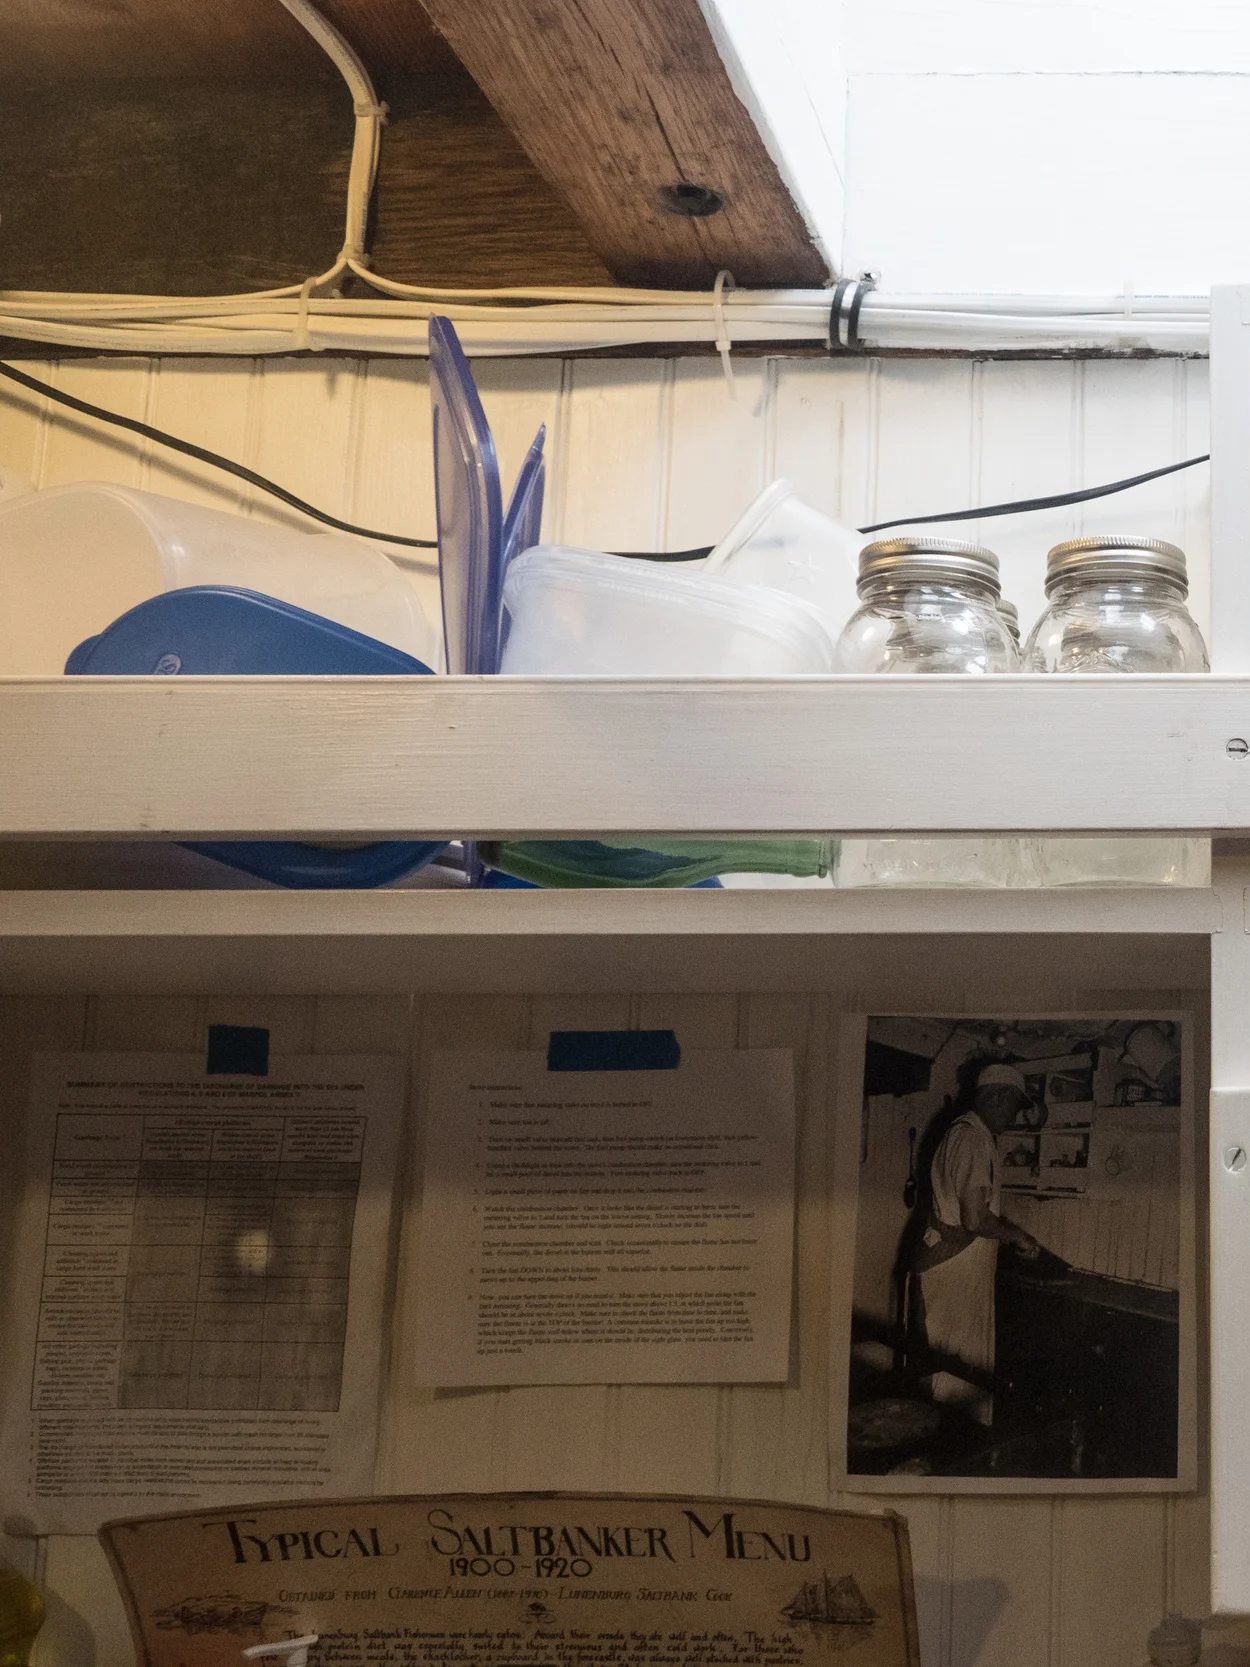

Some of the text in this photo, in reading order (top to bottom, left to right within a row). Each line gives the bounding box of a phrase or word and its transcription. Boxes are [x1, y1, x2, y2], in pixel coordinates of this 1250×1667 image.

[202, 1509, 809, 1564] TYPICAL SALTBANKER MENU
[279, 1589, 335, 1602] OBTAINED
[345, 1590, 376, 1600] FROM
[388, 1586, 442, 1599] CLARENCE
[442, 1586, 482, 1599] ALLEN
[558, 1587, 630, 1600] LUNENBURG
[636, 1588, 697, 1601] SALTBANK
[706, 1588, 732, 1601] COOK
[363, 1629, 401, 1639] Saltbank
[403, 1629, 445, 1639] Fishermen
[534, 1629, 565, 1639] Aboard
[630, 1632, 646, 1642] they
[669, 1631, 686, 1641] well
[690, 1632, 707, 1641] and
[744, 1631, 764, 1644] The
[771, 1632, 792, 1644] high
[328, 1642, 360, 1651] protein
[367, 1642, 386, 1650] diet
[394, 1643, 413, 1651] was
[418, 1641, 464, 1651] especially
[472, 1640, 504, 1650] suited
[512, 1641, 521, 1650] to
[526, 1640, 550, 1650] their
[555, 1642, 602, 1651] strenuous
[609, 1641, 627, 1651] and
[634, 1643, 659, 1652] often
[667, 1642, 687, 1652] cold
[732, 1643, 749, 1653] For
[755, 1643, 779, 1653] those
[784, 1644, 804, 1654] who
[325, 1653, 361, 1661] between
[404, 1652, 417, 1660] the
[559, 1652, 572, 1661] the
[628, 1654, 645, 1662] was
[649, 1654, 680, 1663] always
[685, 1654, 702, 1663] well
[743, 1655, 760, 1664] with
